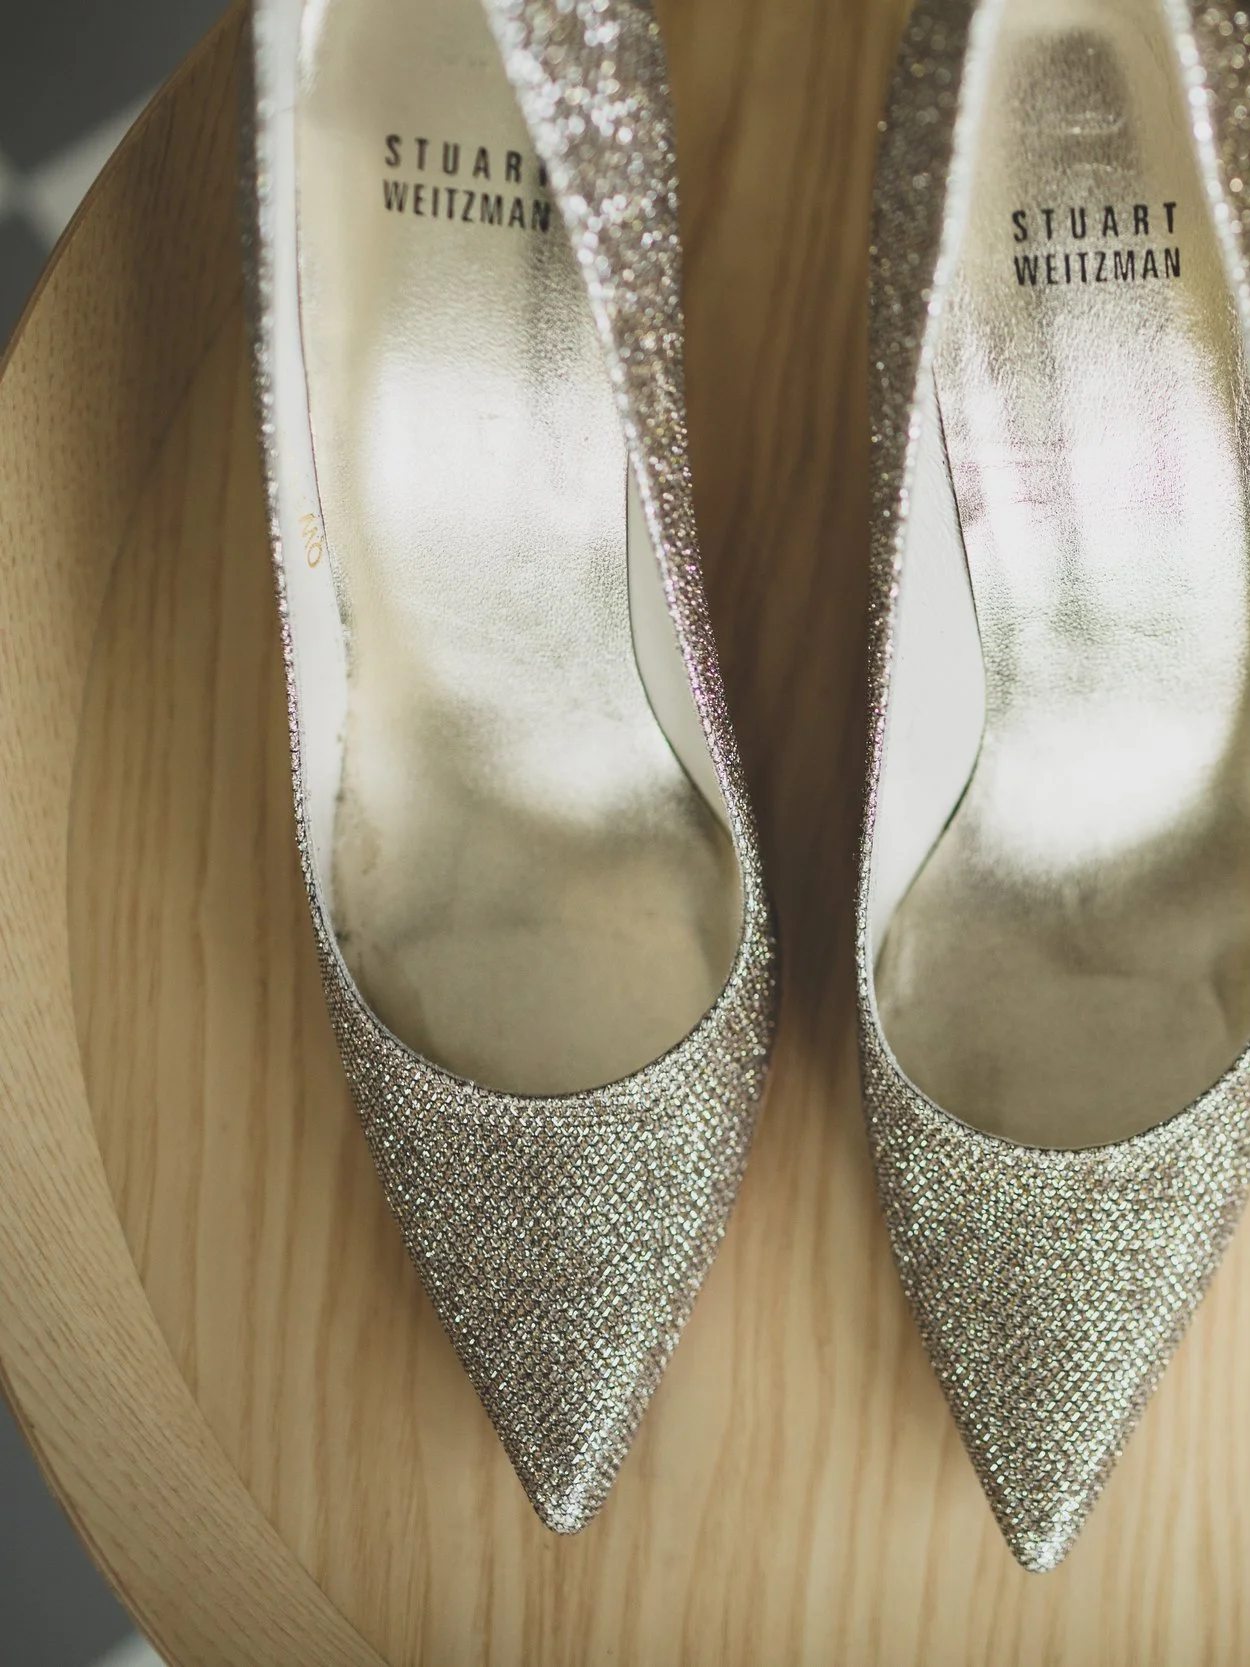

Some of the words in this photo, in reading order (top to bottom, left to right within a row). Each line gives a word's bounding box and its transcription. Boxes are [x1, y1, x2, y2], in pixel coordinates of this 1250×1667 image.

[382, 178, 551, 233] WEITZMAN
[1011, 201, 1177, 243] STUART
[1013, 246, 1181, 286] WEITZMAN
